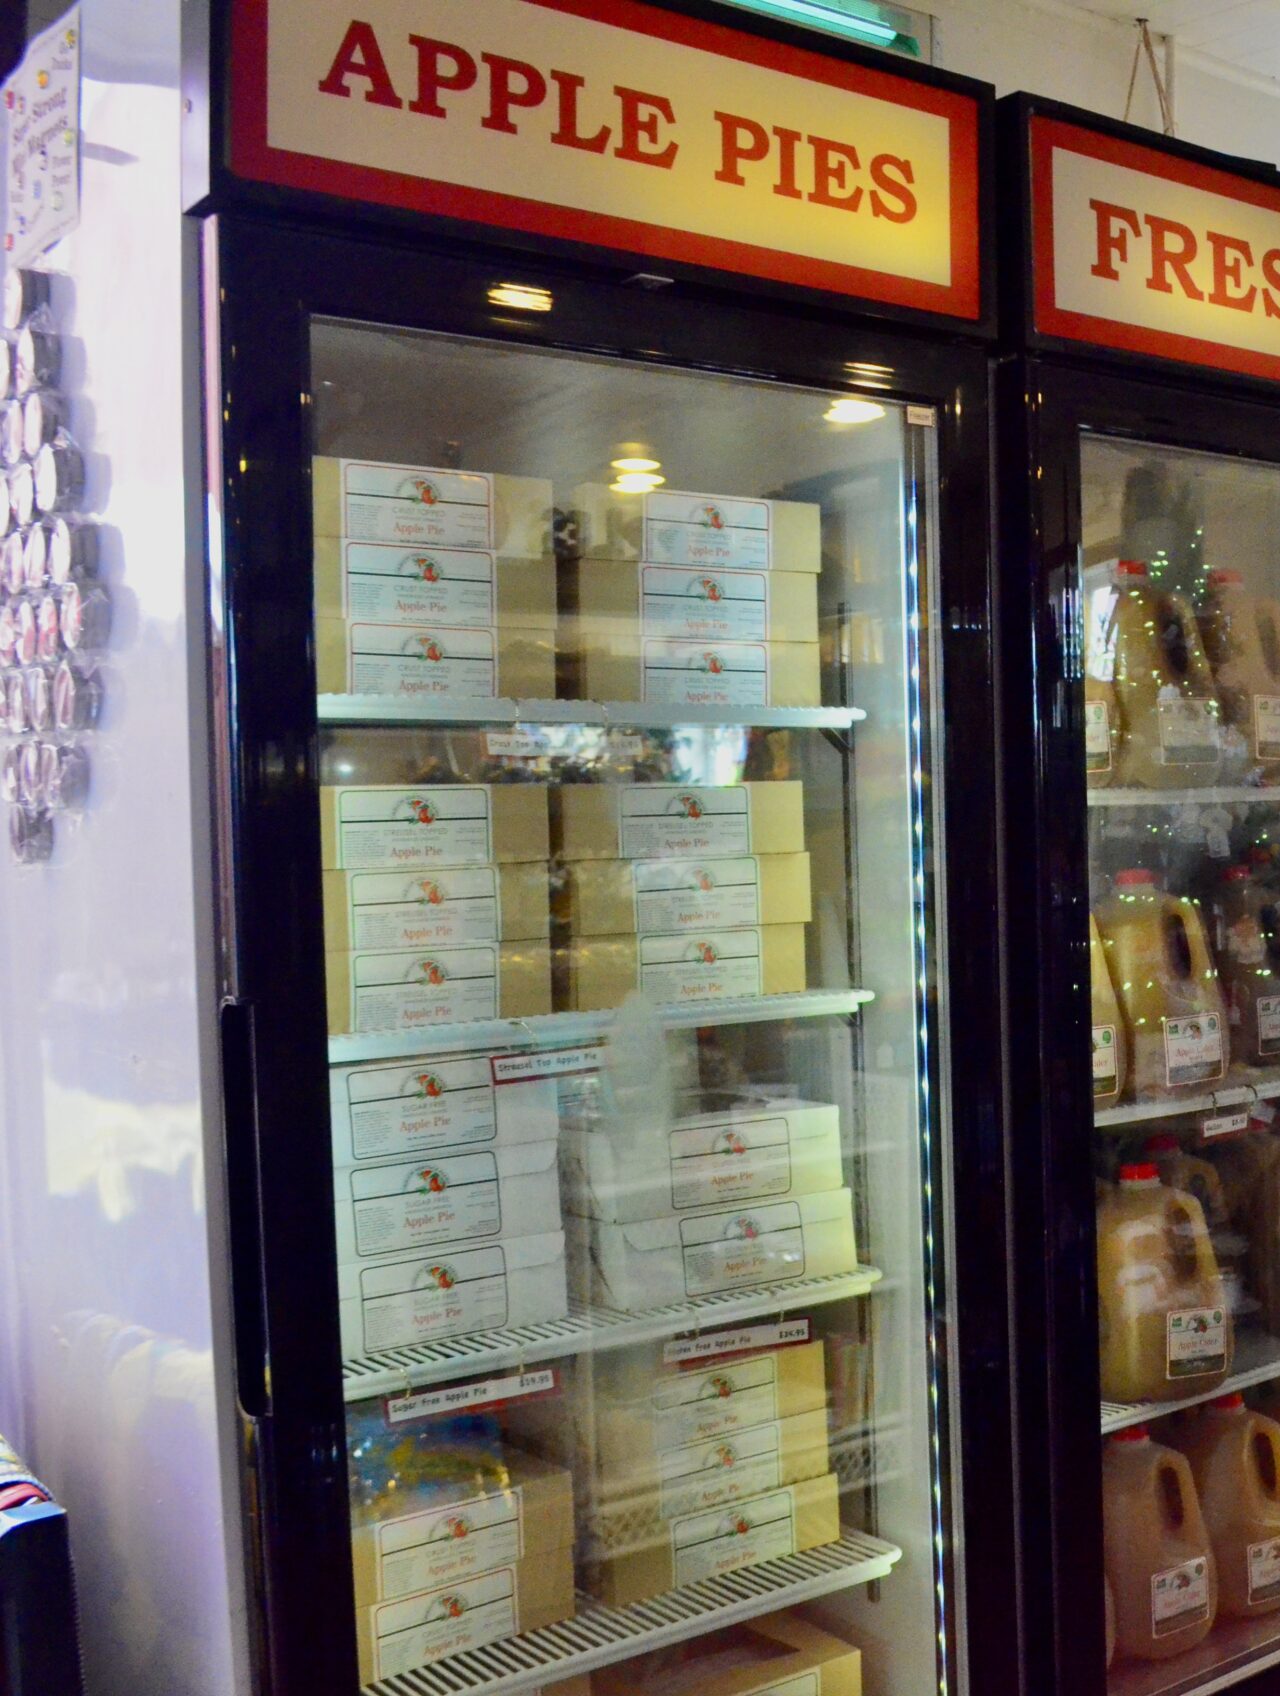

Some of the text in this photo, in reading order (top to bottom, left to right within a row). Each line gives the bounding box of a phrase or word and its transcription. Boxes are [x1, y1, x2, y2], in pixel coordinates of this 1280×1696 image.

[319, 20, 917, 224] APPLE PIES
[393, 522, 445, 536] Apple Pie
[688, 545, 730, 557] Apple Pie
[395, 600, 447, 613] Apple Pie
[400, 680, 449, 692] Apple Pie
[664, 838, 710, 851] Apple Pie
[390, 846, 443, 860] Apple Pie
[403, 926, 453, 940] Apple Pie
[681, 982, 723, 996] Apple Pie
[403, 1006, 453, 1020] Apple Pie
[556, 1055, 580, 1065] Apple
[400, 1116, 450, 1132] Apple Pie
[711, 1171, 753, 1187] Apple Pie
[404, 1210, 455, 1228] Apple Pie
[412, 1306, 463, 1326] Apple Pie
[391, 1401, 417, 1413] Sugar
[422, 1397, 440, 1406] Free
[445, 1392, 469, 1402] Apple
[473, 1387, 487, 1397] Pie
